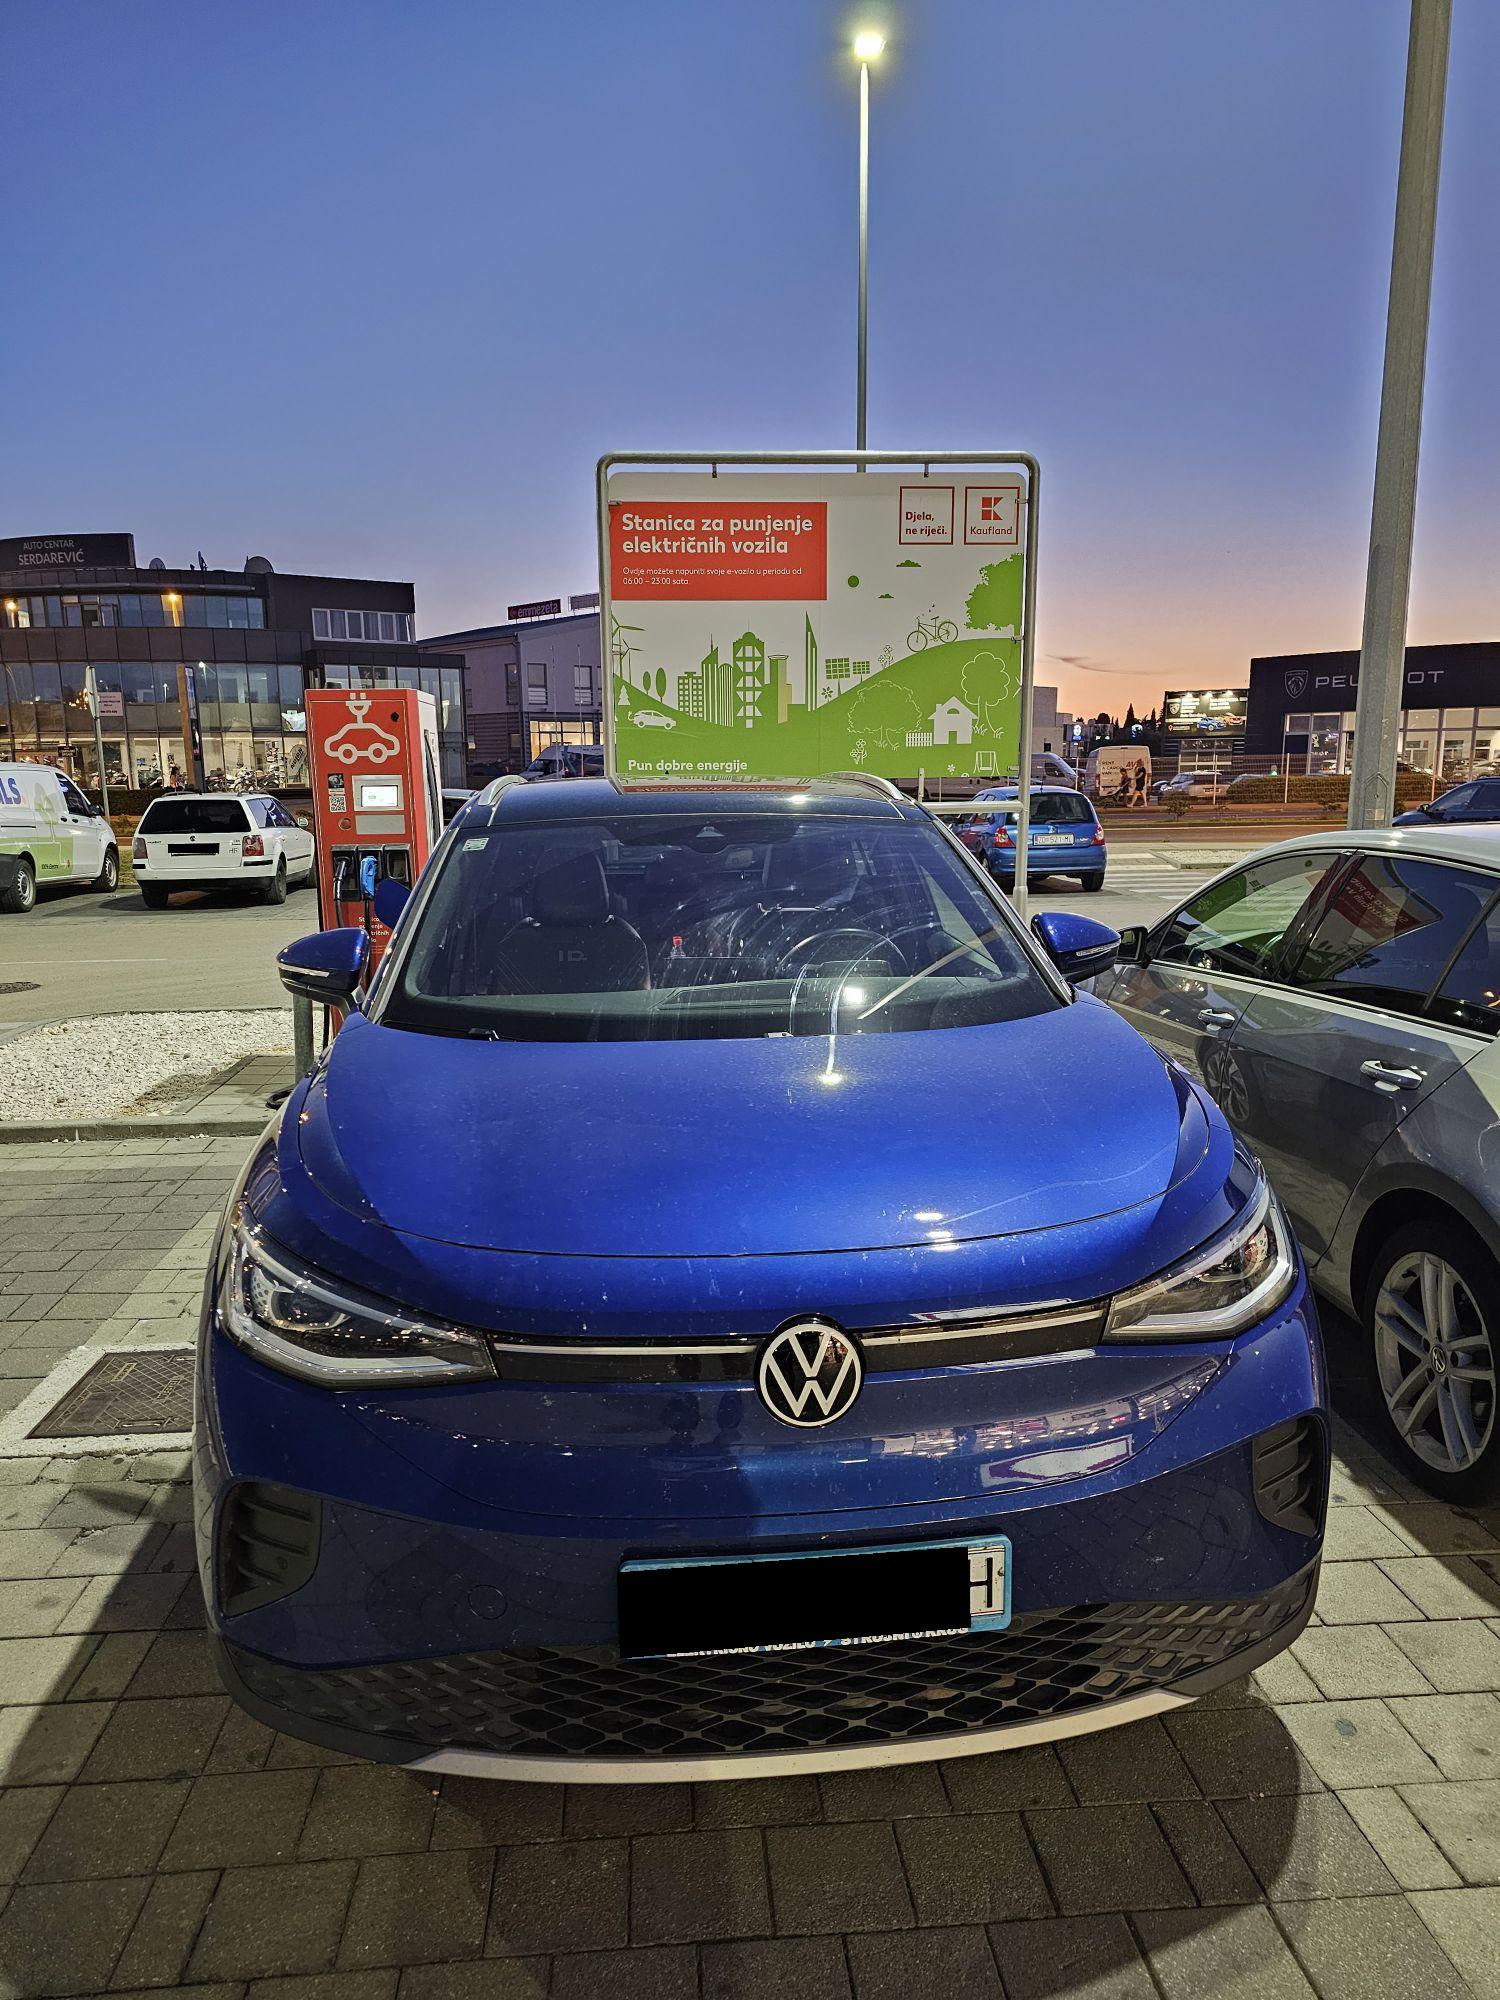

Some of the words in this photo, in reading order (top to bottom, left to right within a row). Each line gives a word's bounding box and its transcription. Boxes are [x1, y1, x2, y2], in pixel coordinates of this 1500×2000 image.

[905, 511, 935, 522] Djela,
[622, 513, 695, 531] Stanica
[701, 518, 724, 531] za
[729, 514, 813, 536] punjenje
[970, 526, 1013, 535] Kaufland
[905, 527, 917, 535] ne
[920, 526, 948, 536] riječi.
[23, 541, 43, 550] AUTO
[44, 540, 75, 549] CENTAR
[622, 535, 726, 553] električnih
[731, 536, 788, 553] vozila
[18, 548, 85, 566] SERDAREVIĆ
[622, 566, 645, 577] Ovdje
[646, 567, 673, 575] možete
[675, 567, 704, 576] napuniti
[706, 568, 725, 576] svoje
[762, 567, 791, 576] periodu
[792, 567, 802, 575] od
[518, 601, 559, 618] emmezeta
[628, 759, 653, 771] Pun
[656, 759, 694, 771] dobre
[696, 760, 748, 773] energije
